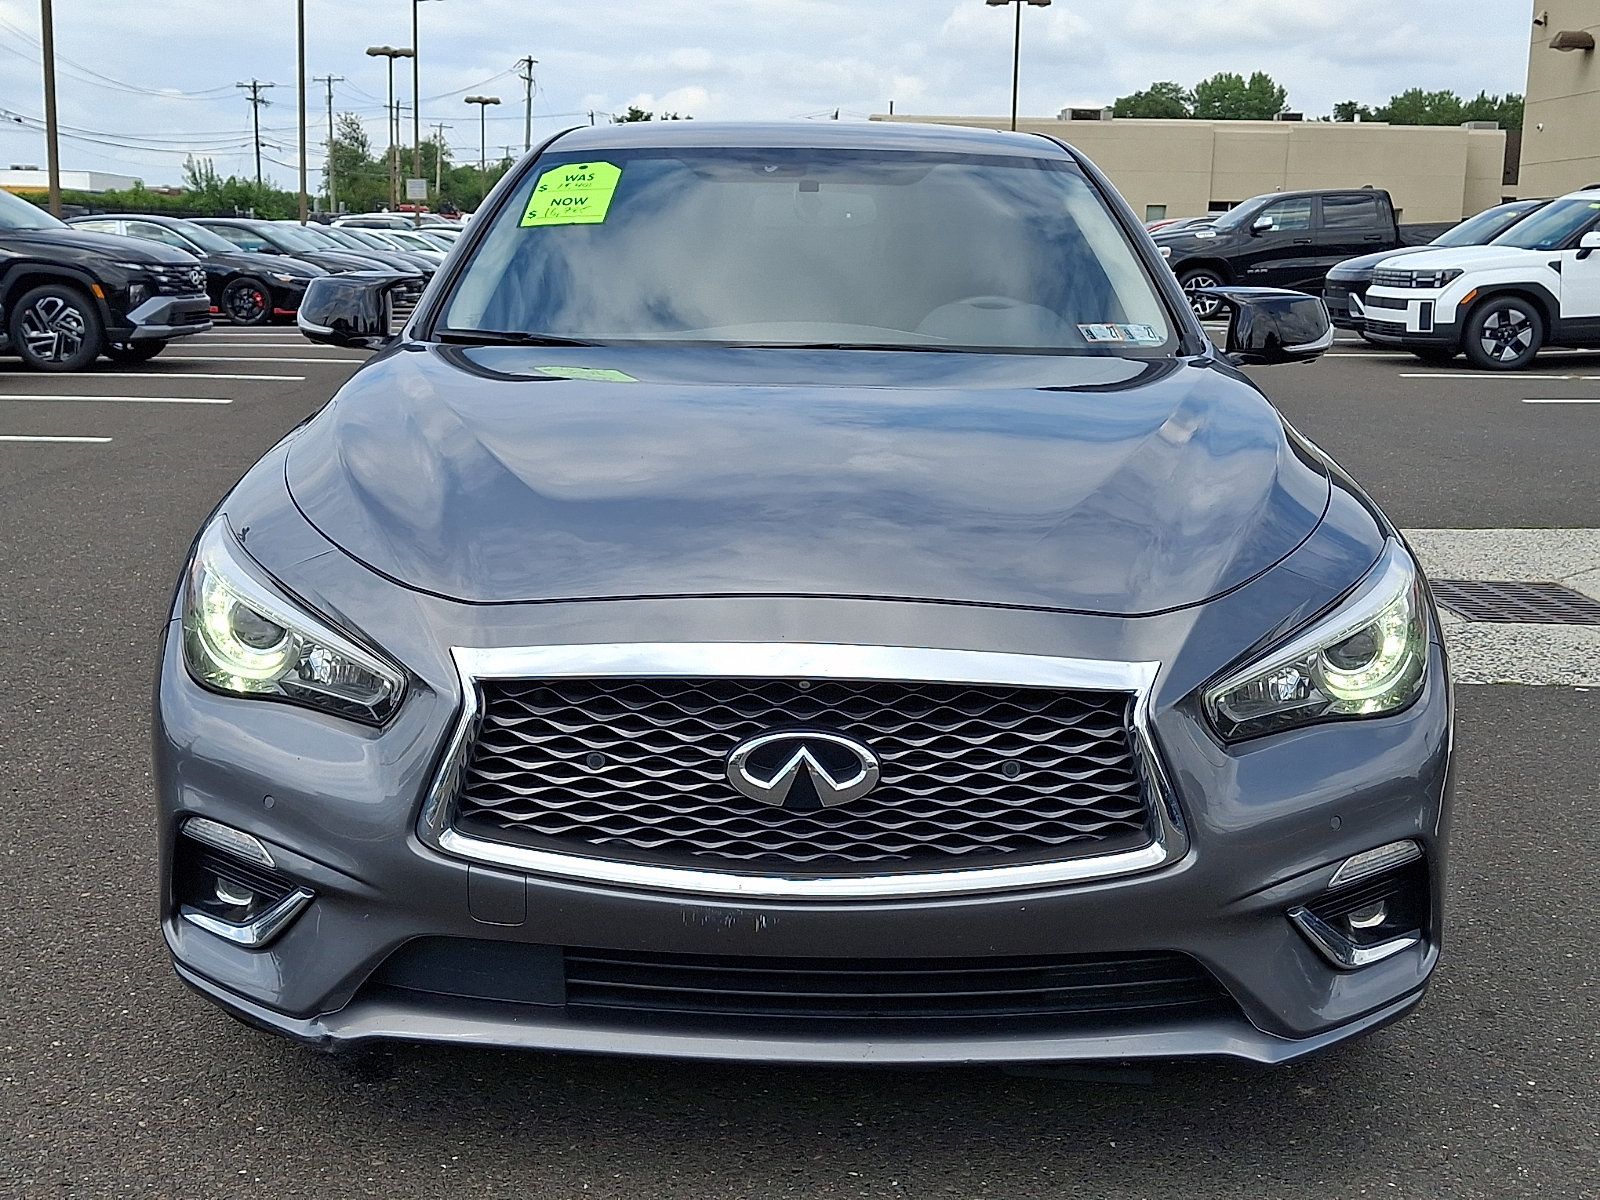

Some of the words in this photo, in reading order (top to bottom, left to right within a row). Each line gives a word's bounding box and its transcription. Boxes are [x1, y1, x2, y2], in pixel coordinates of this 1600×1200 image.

[565, 173, 595, 182] WAS
[538, 184, 548, 192] $
[550, 197, 589, 206] NOW
[527, 210, 537, 219] $
